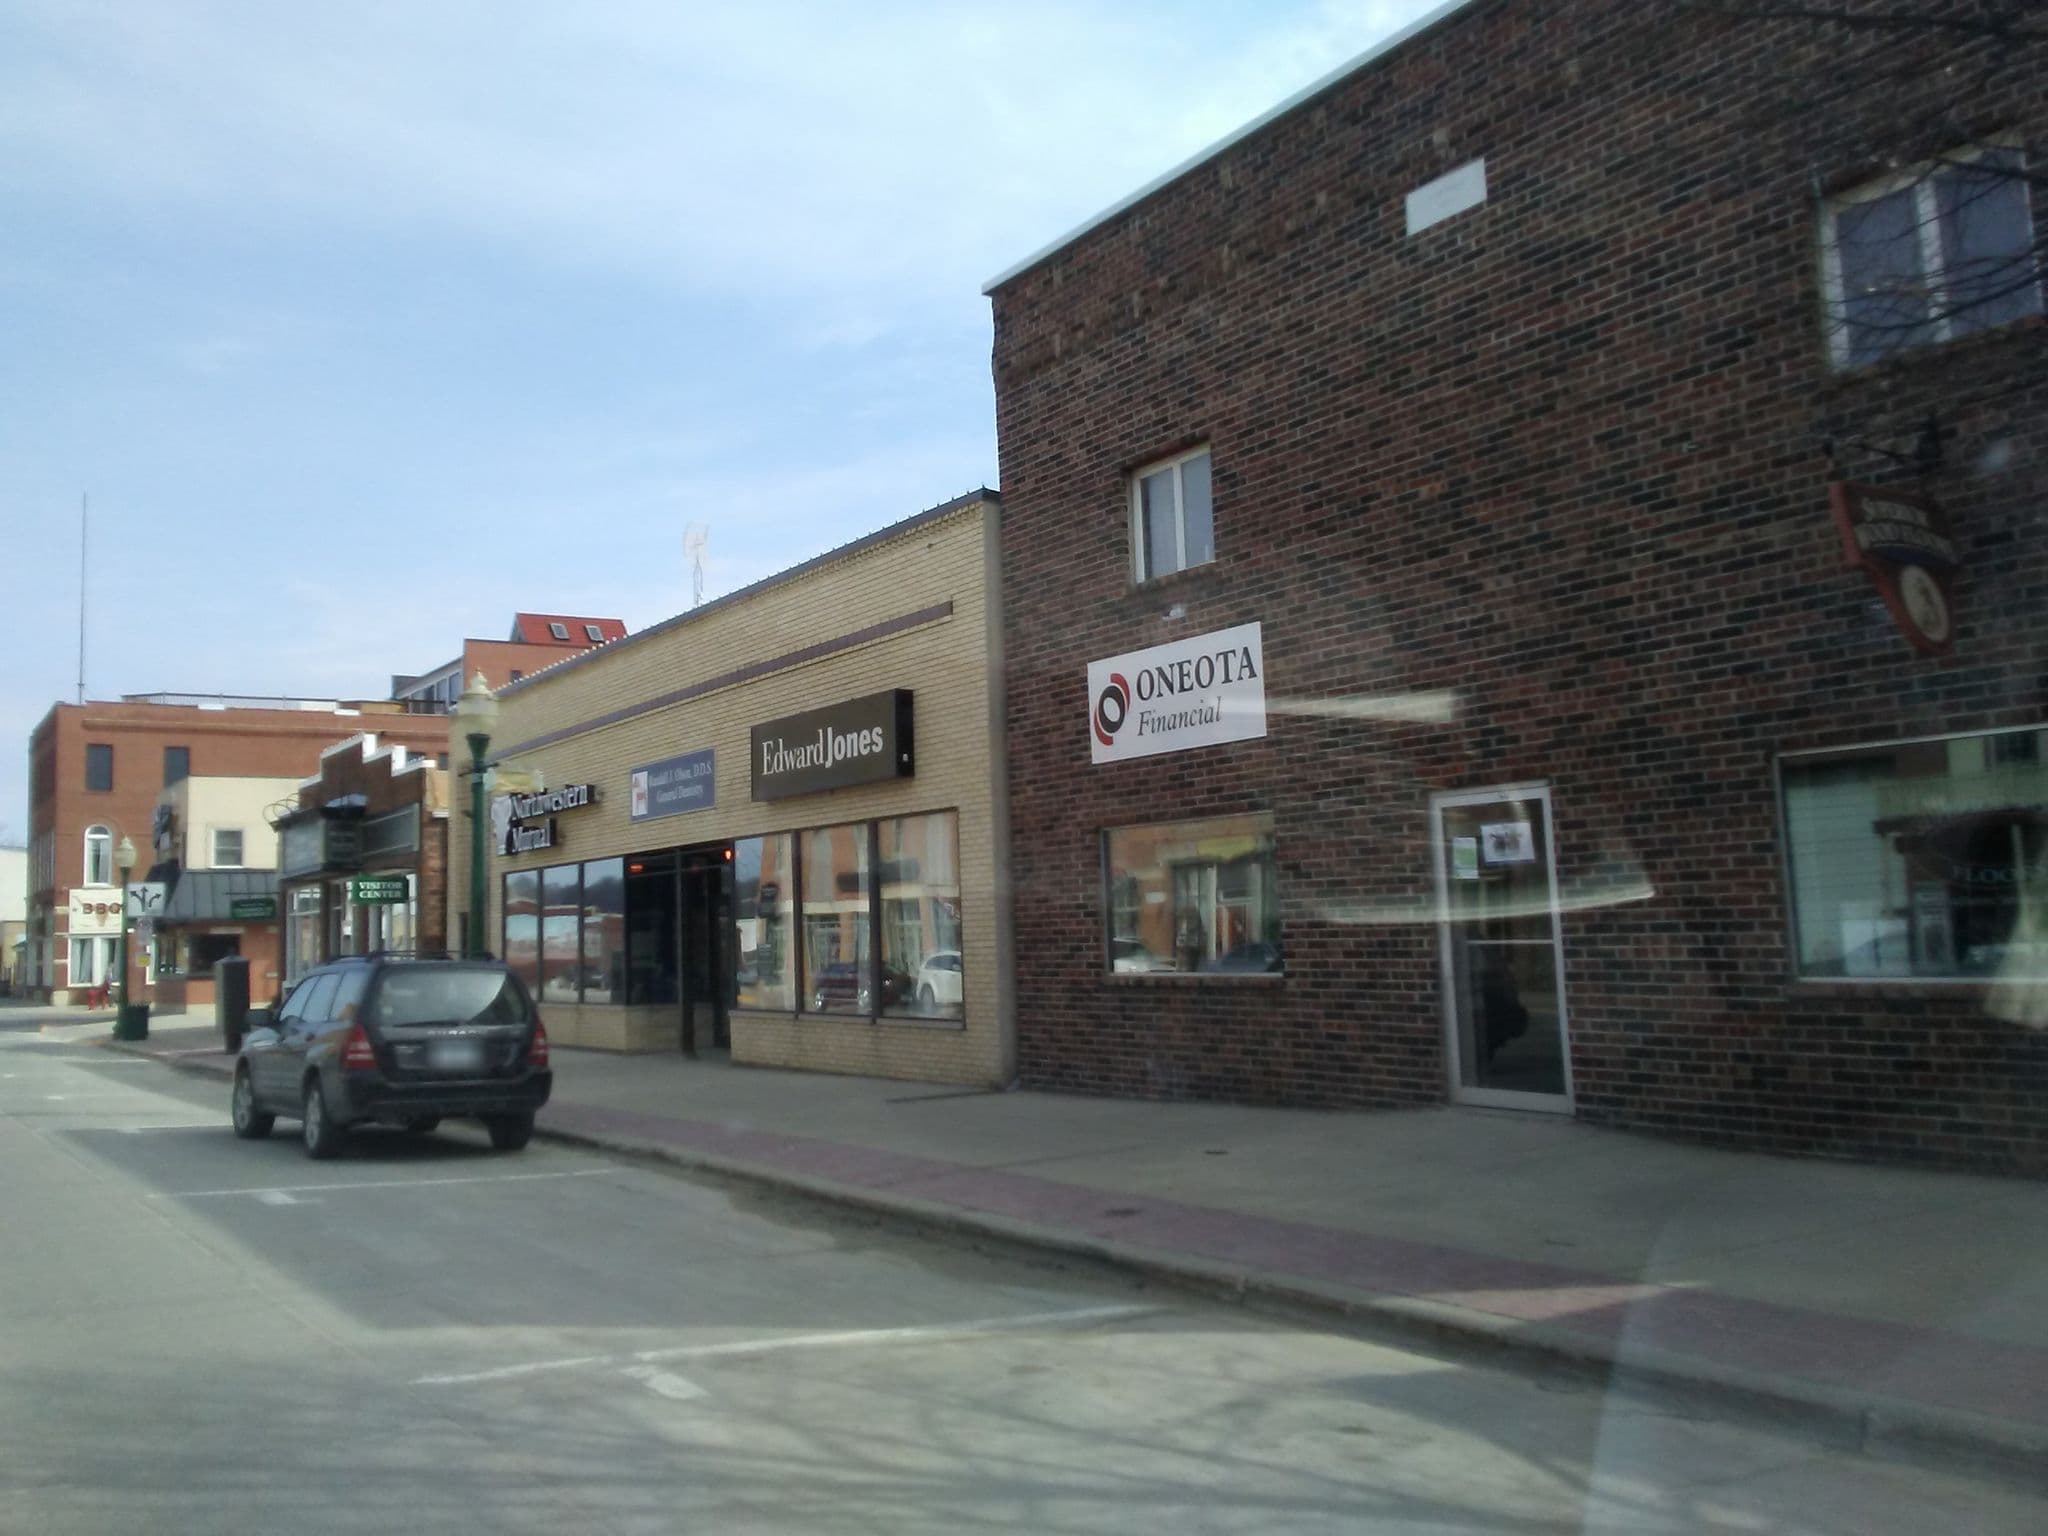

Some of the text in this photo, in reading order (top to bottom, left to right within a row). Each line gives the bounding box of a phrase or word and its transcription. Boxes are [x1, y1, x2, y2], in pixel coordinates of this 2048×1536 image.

[1136, 646, 1257, 701] ONEOTA
[1137, 696, 1222, 737] Financial
[359, 880, 403, 889] VISITOR
[359, 890, 402, 899] CENTER
